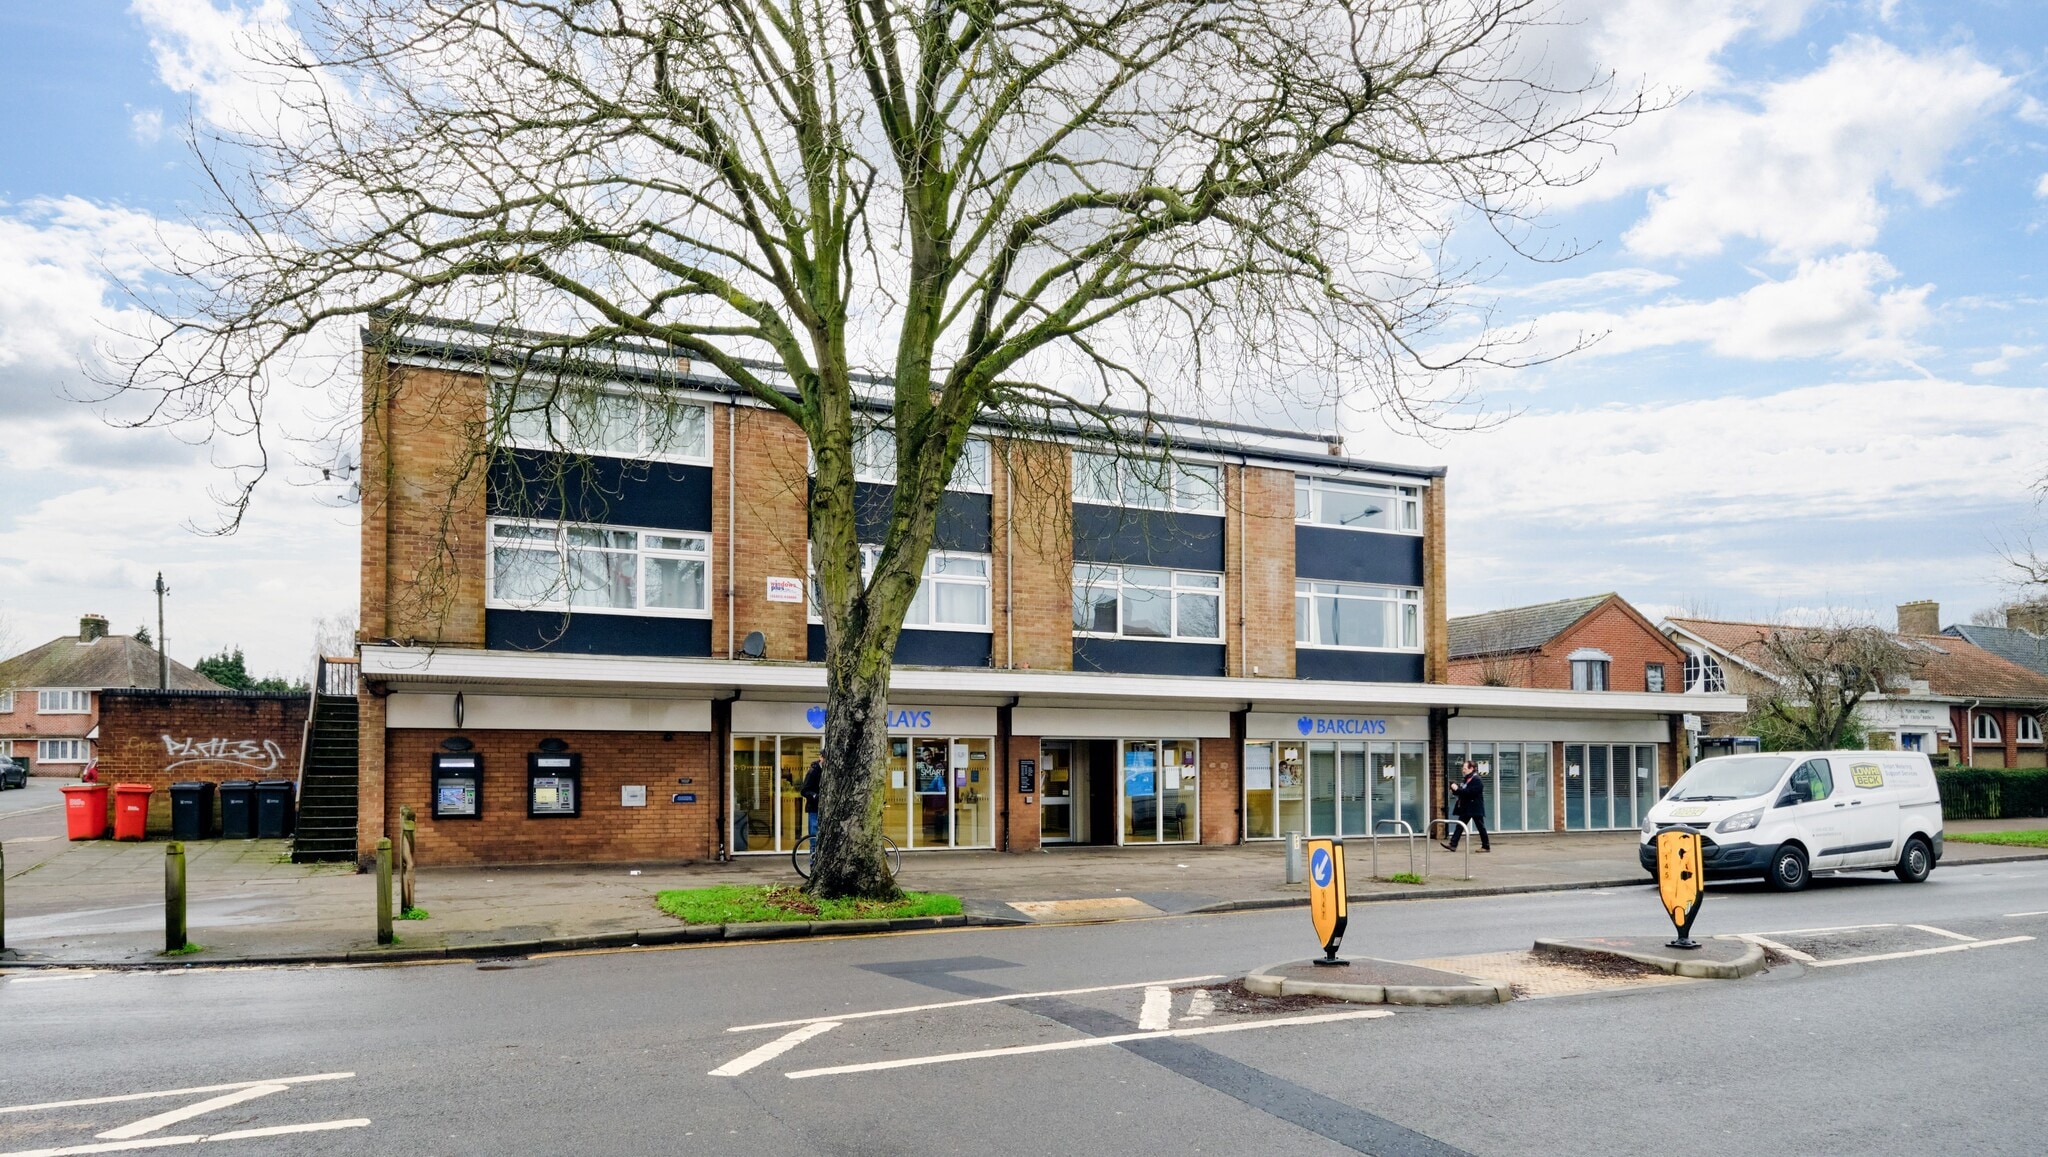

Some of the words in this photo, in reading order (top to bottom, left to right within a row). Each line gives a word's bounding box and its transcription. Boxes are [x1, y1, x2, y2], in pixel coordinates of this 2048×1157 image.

[770, 580, 797, 588] windows
[888, 710, 932, 728] LAYS
[1316, 718, 1386, 734] BARCLAYS
[920, 768, 946, 776] SMART
[1852, 767, 1880, 775] LOWRI
[1857, 776, 1880, 785] BECK
